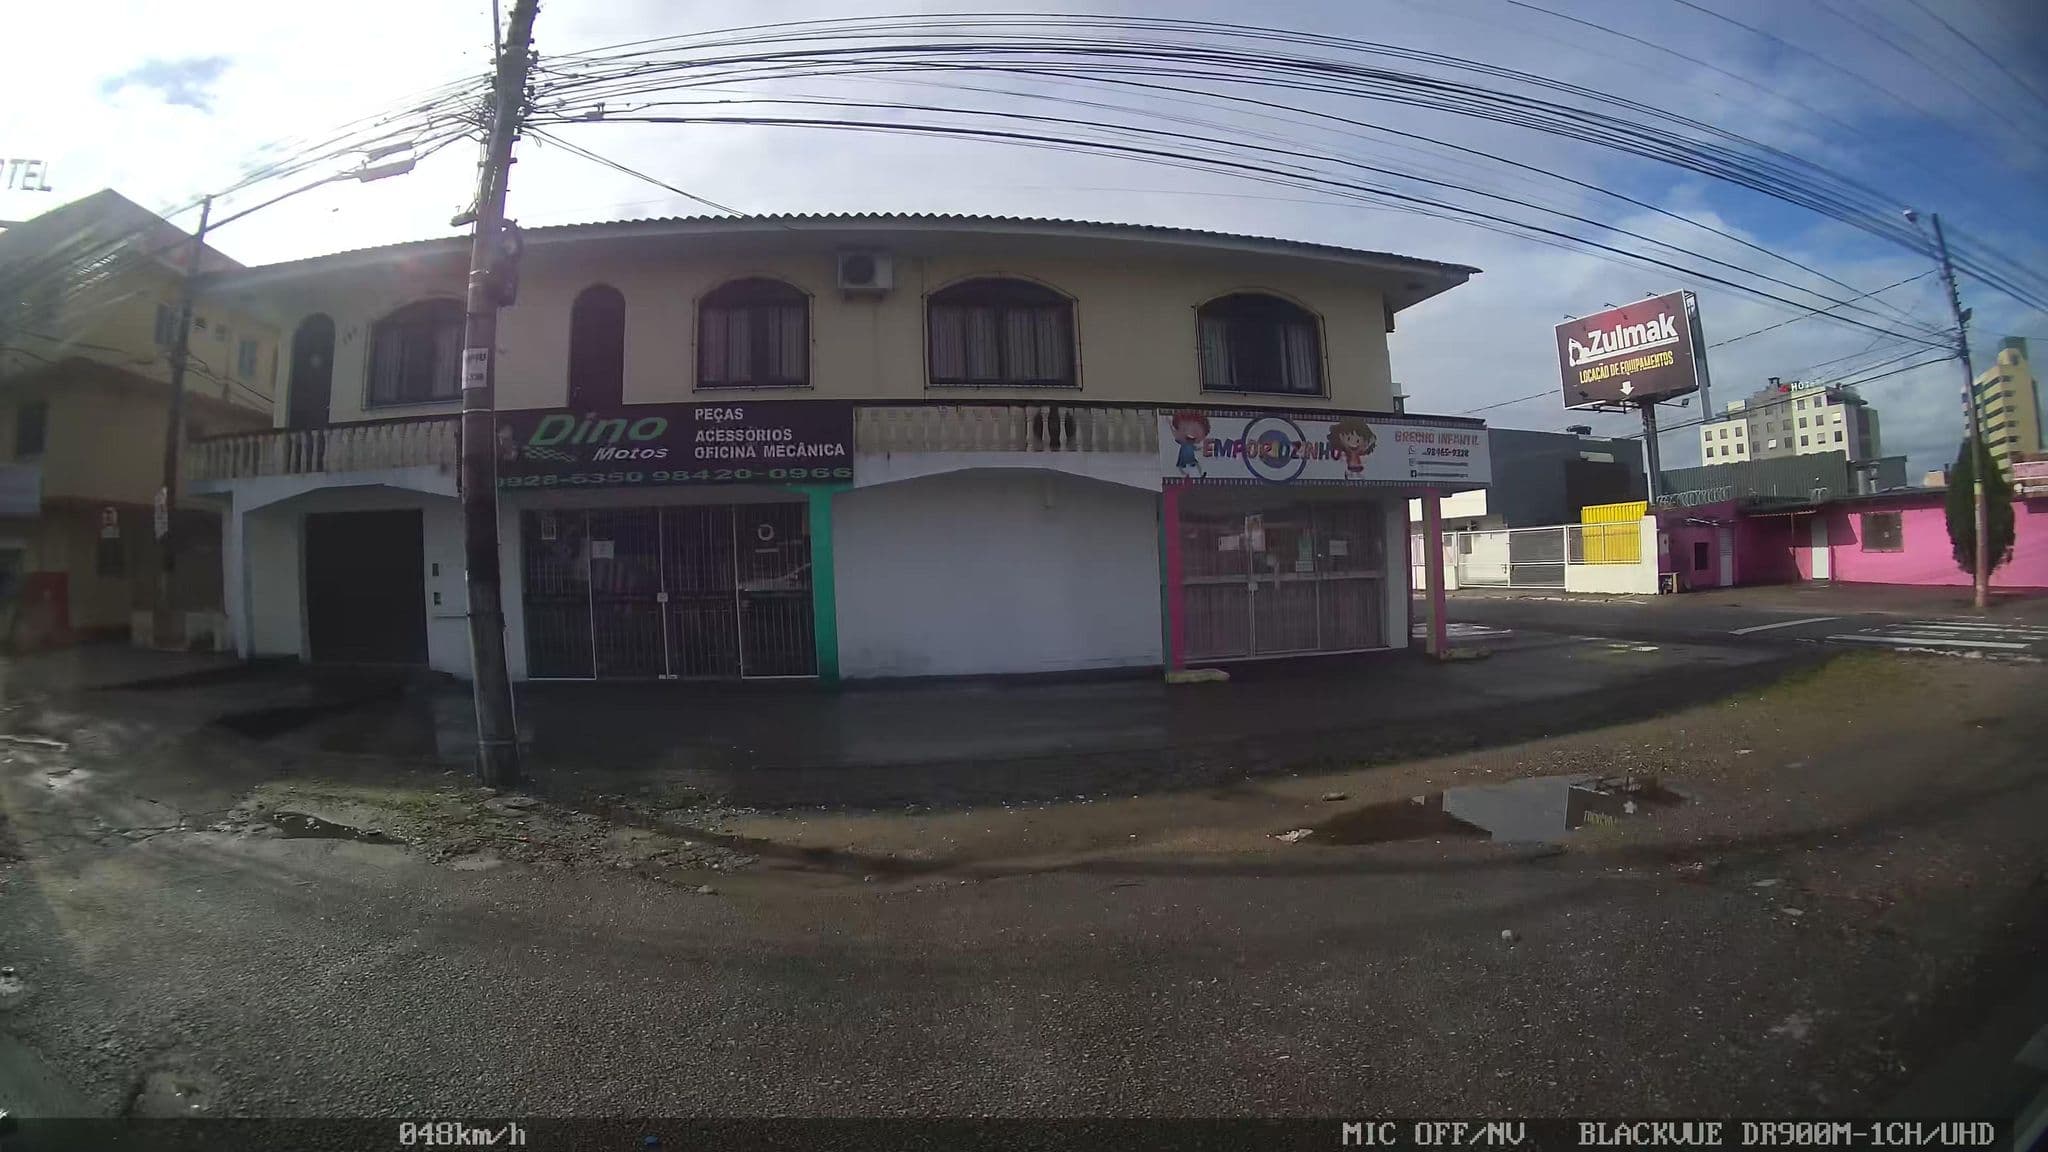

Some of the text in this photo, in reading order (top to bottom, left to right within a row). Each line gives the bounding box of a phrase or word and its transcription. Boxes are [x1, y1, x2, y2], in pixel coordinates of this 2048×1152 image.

[1588, 313, 1679, 353] Zulmak
[1579, 350, 1674, 384] LOCAÇÃO DE EQUIPAMENTOS
[695, 408, 744, 422] PEÇAS
[528, 413, 668, 446] Dino
[592, 447, 669, 461] Motos
[694, 442, 846, 459] OFICINA MECÂNICA
[652, 467, 852, 482] 98420-0966
